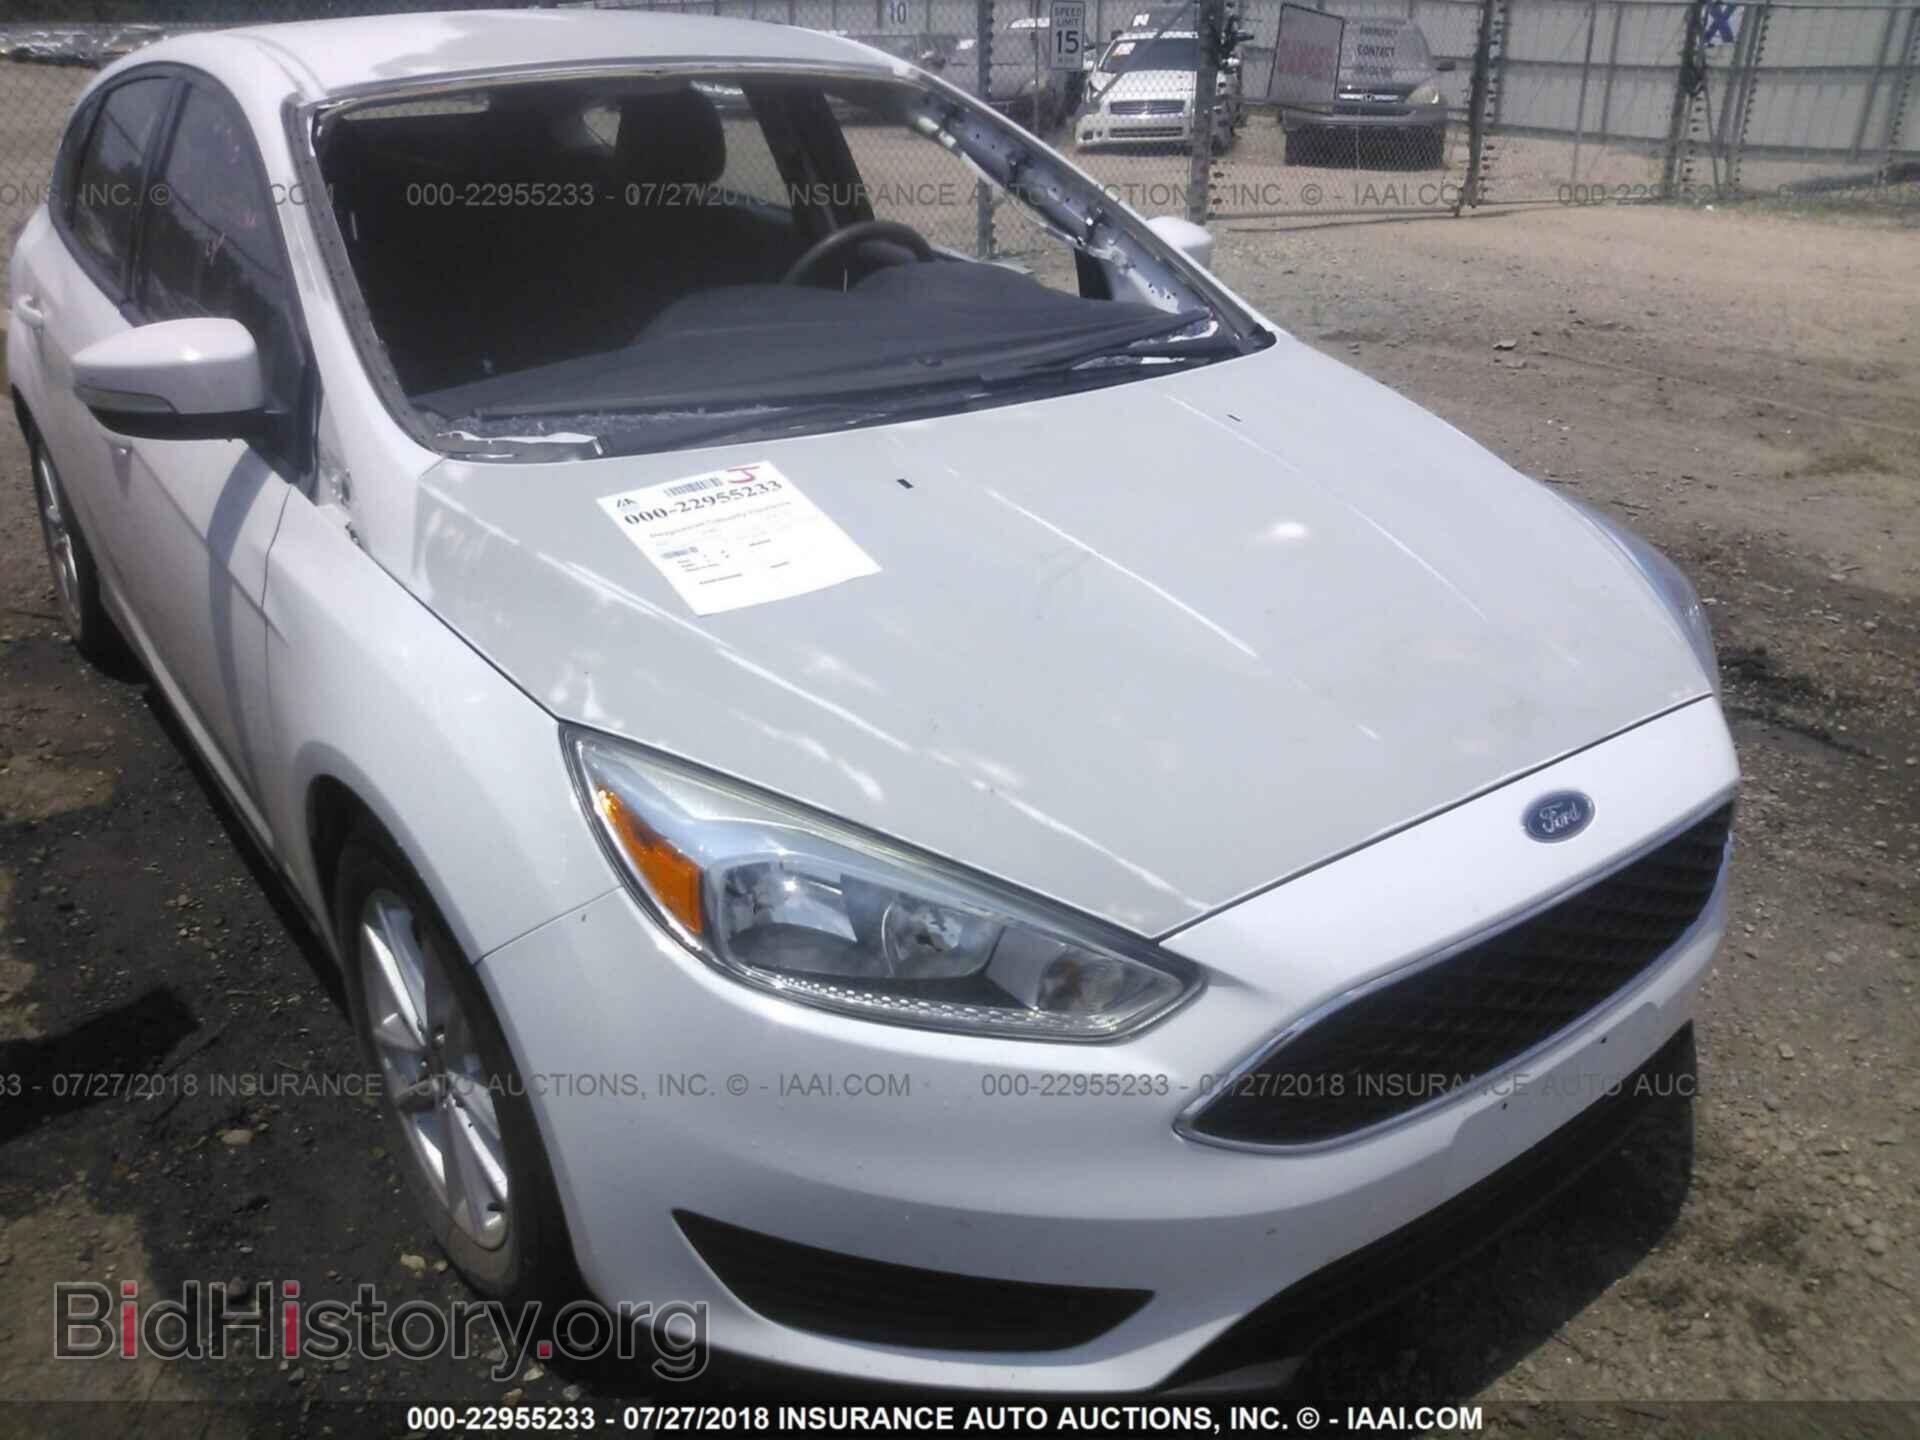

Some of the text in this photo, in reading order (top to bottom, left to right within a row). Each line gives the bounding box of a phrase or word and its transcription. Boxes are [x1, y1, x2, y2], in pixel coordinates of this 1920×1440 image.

[1054, 7, 1082, 17] SPEED
[1056, 18, 1080, 27] LIMIT
[1056, 30, 1079, 55] 15
[1357, 43, 1395, 57] CONTACT
[624, 479, 783, 525] 000-22955233
[1539, 800, 1580, 833] Ford
